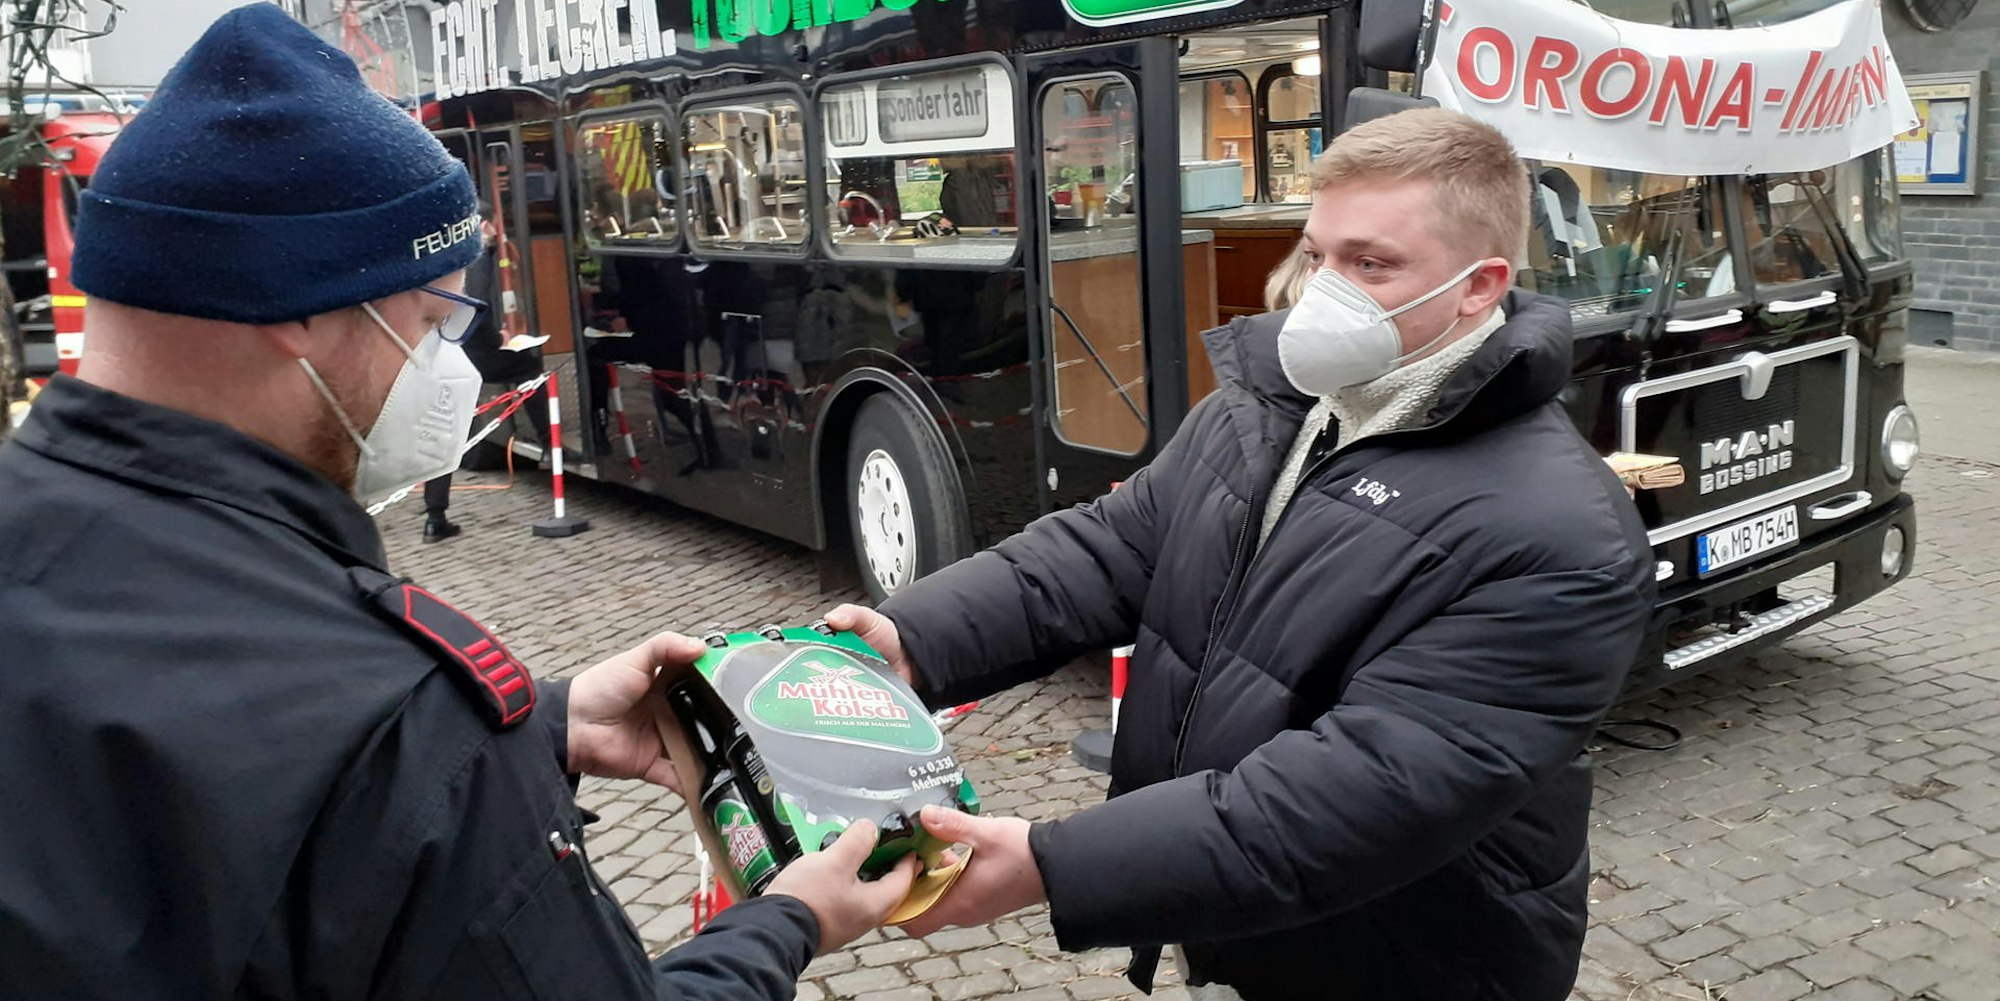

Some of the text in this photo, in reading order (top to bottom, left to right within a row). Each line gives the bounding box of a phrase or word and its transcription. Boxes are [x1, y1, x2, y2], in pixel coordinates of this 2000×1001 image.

[430, 0, 509, 100] ECHT.
[1709, 536, 1720, 566] K
[1731, 526, 1752, 557] MB
[1755, 511, 1796, 548] 754H
[779, 682, 893, 702] Mühlen
[813, 699, 908, 720] Kölsch
[908, 765, 918, 777] 6
[918, 766, 927, 775] x
